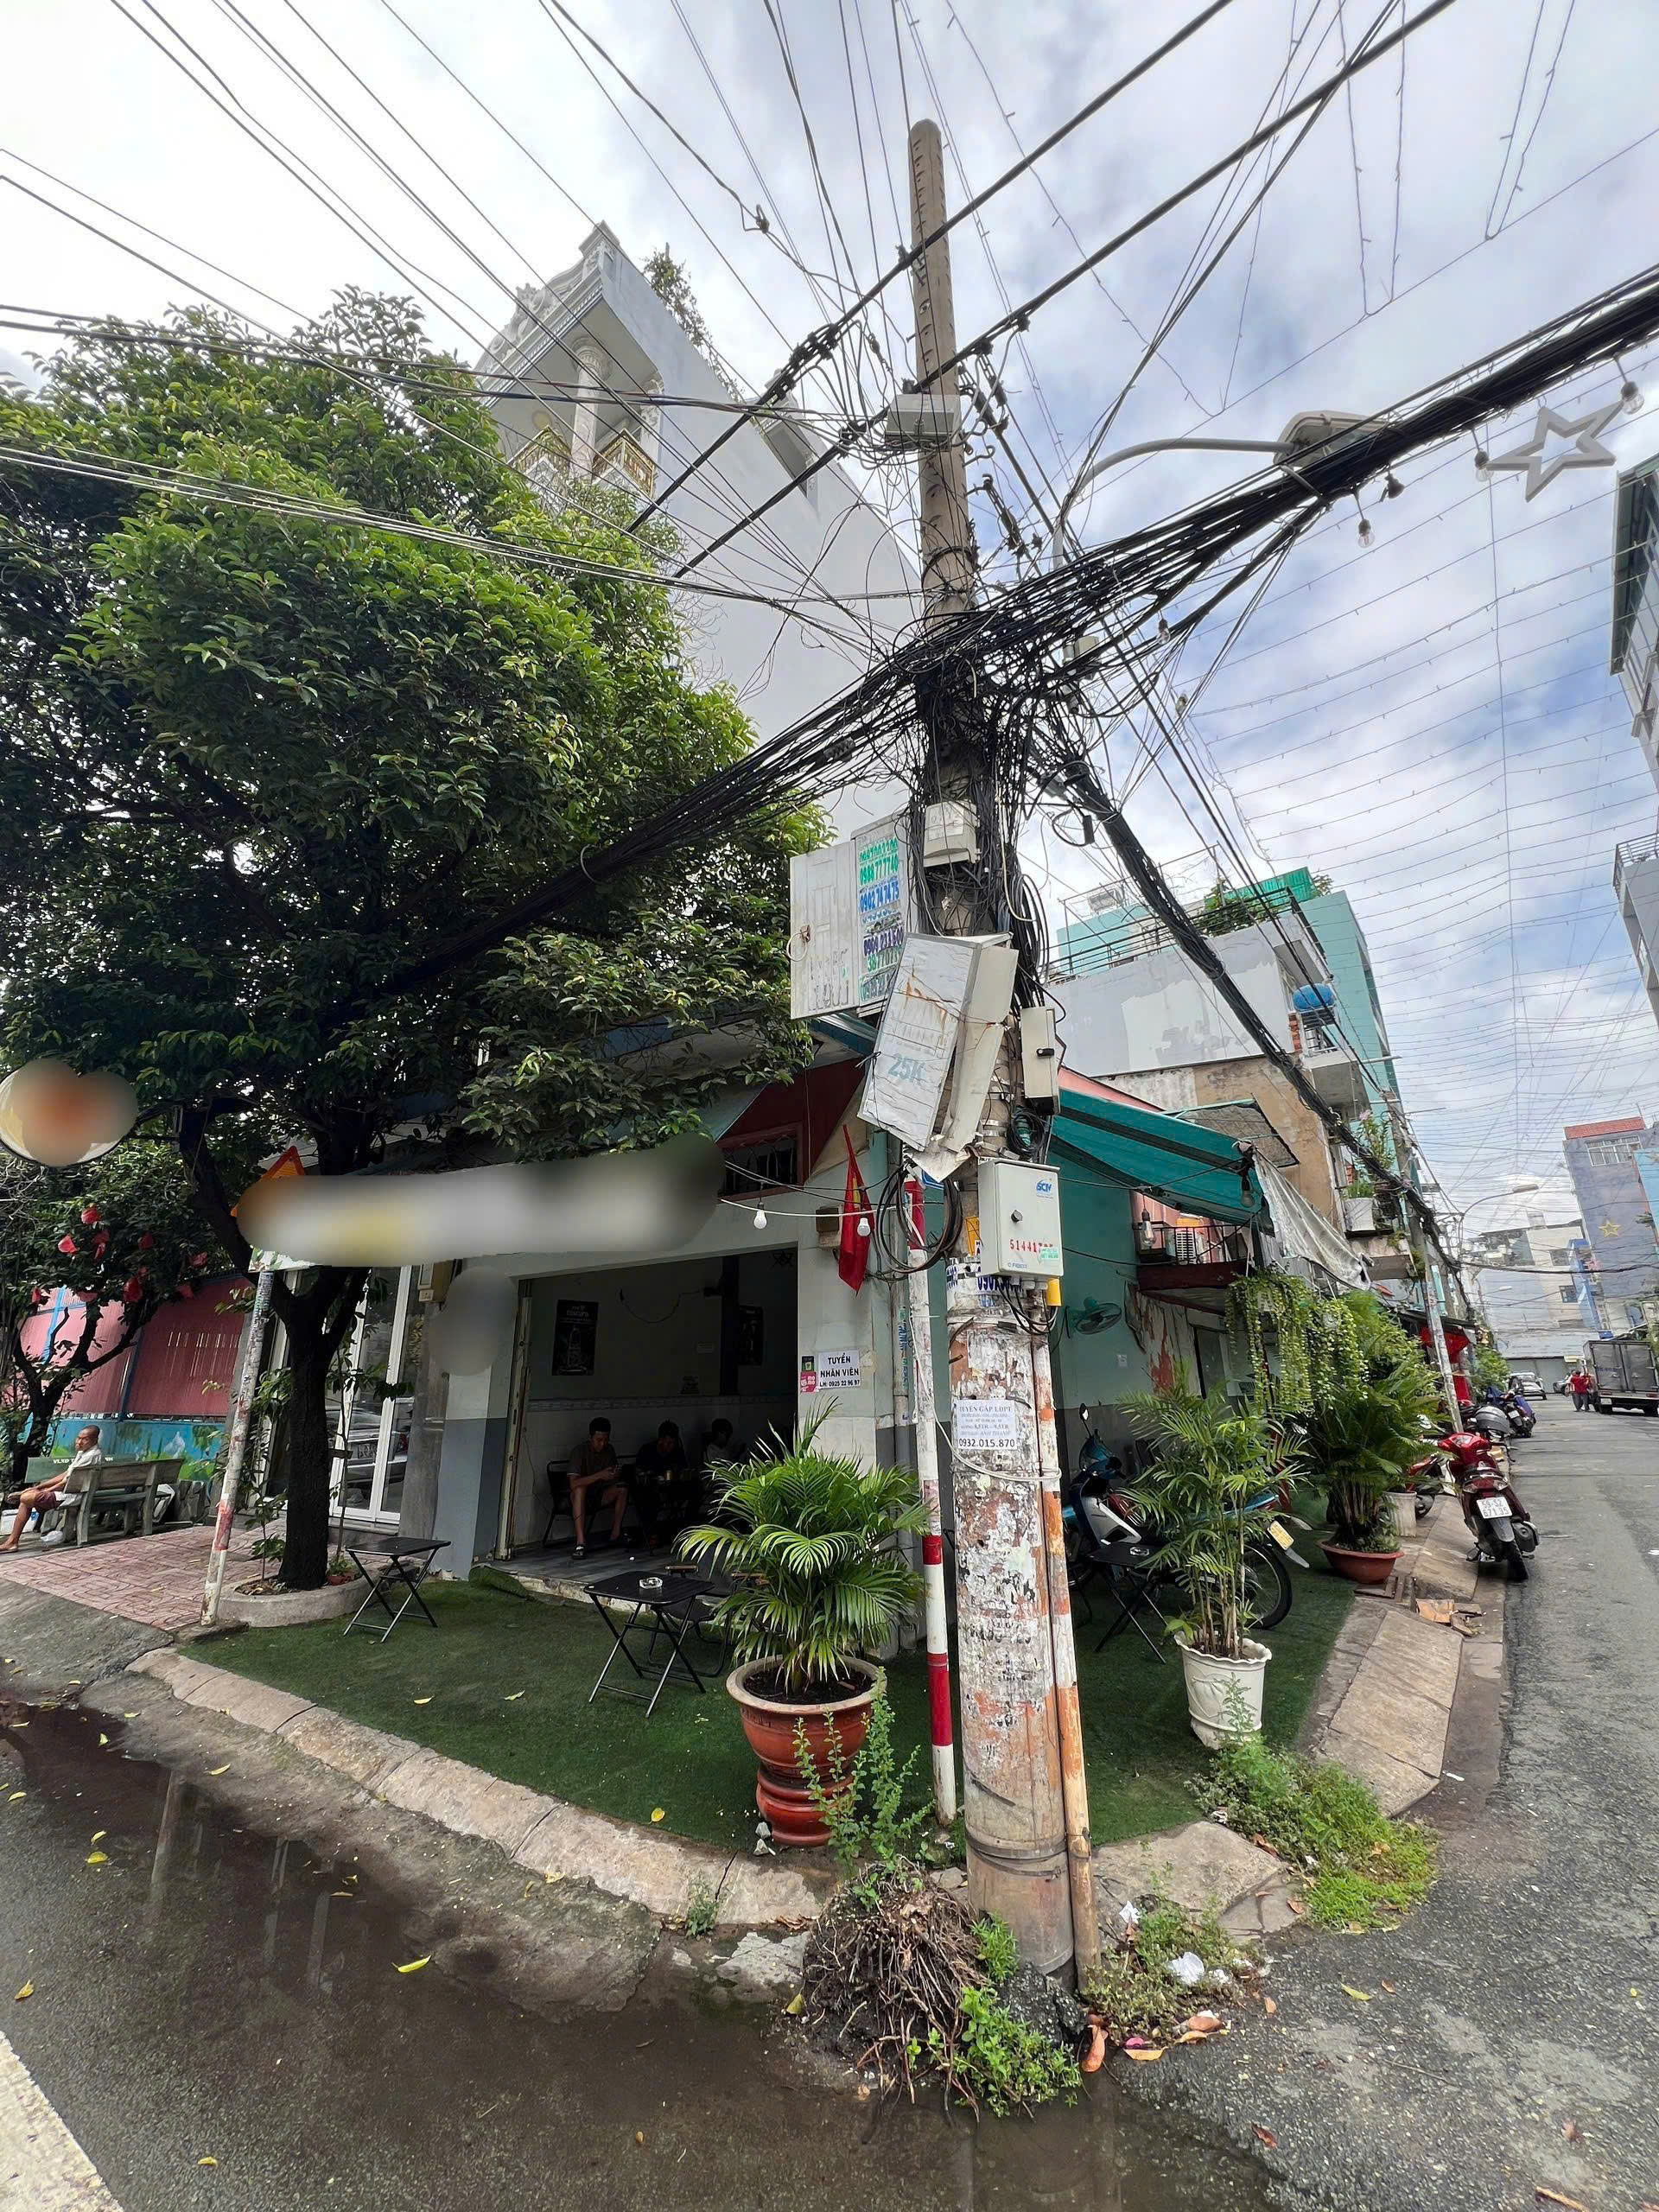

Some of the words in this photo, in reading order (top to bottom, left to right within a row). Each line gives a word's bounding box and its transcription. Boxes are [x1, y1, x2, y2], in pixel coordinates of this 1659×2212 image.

[828, 1352, 851, 1364] TUYỂN
[820, 1369, 841, 1378] NHÂN
[842, 1367, 860, 1376] VIÊN
[958, 1438, 1015, 1448] 0932.015.870
